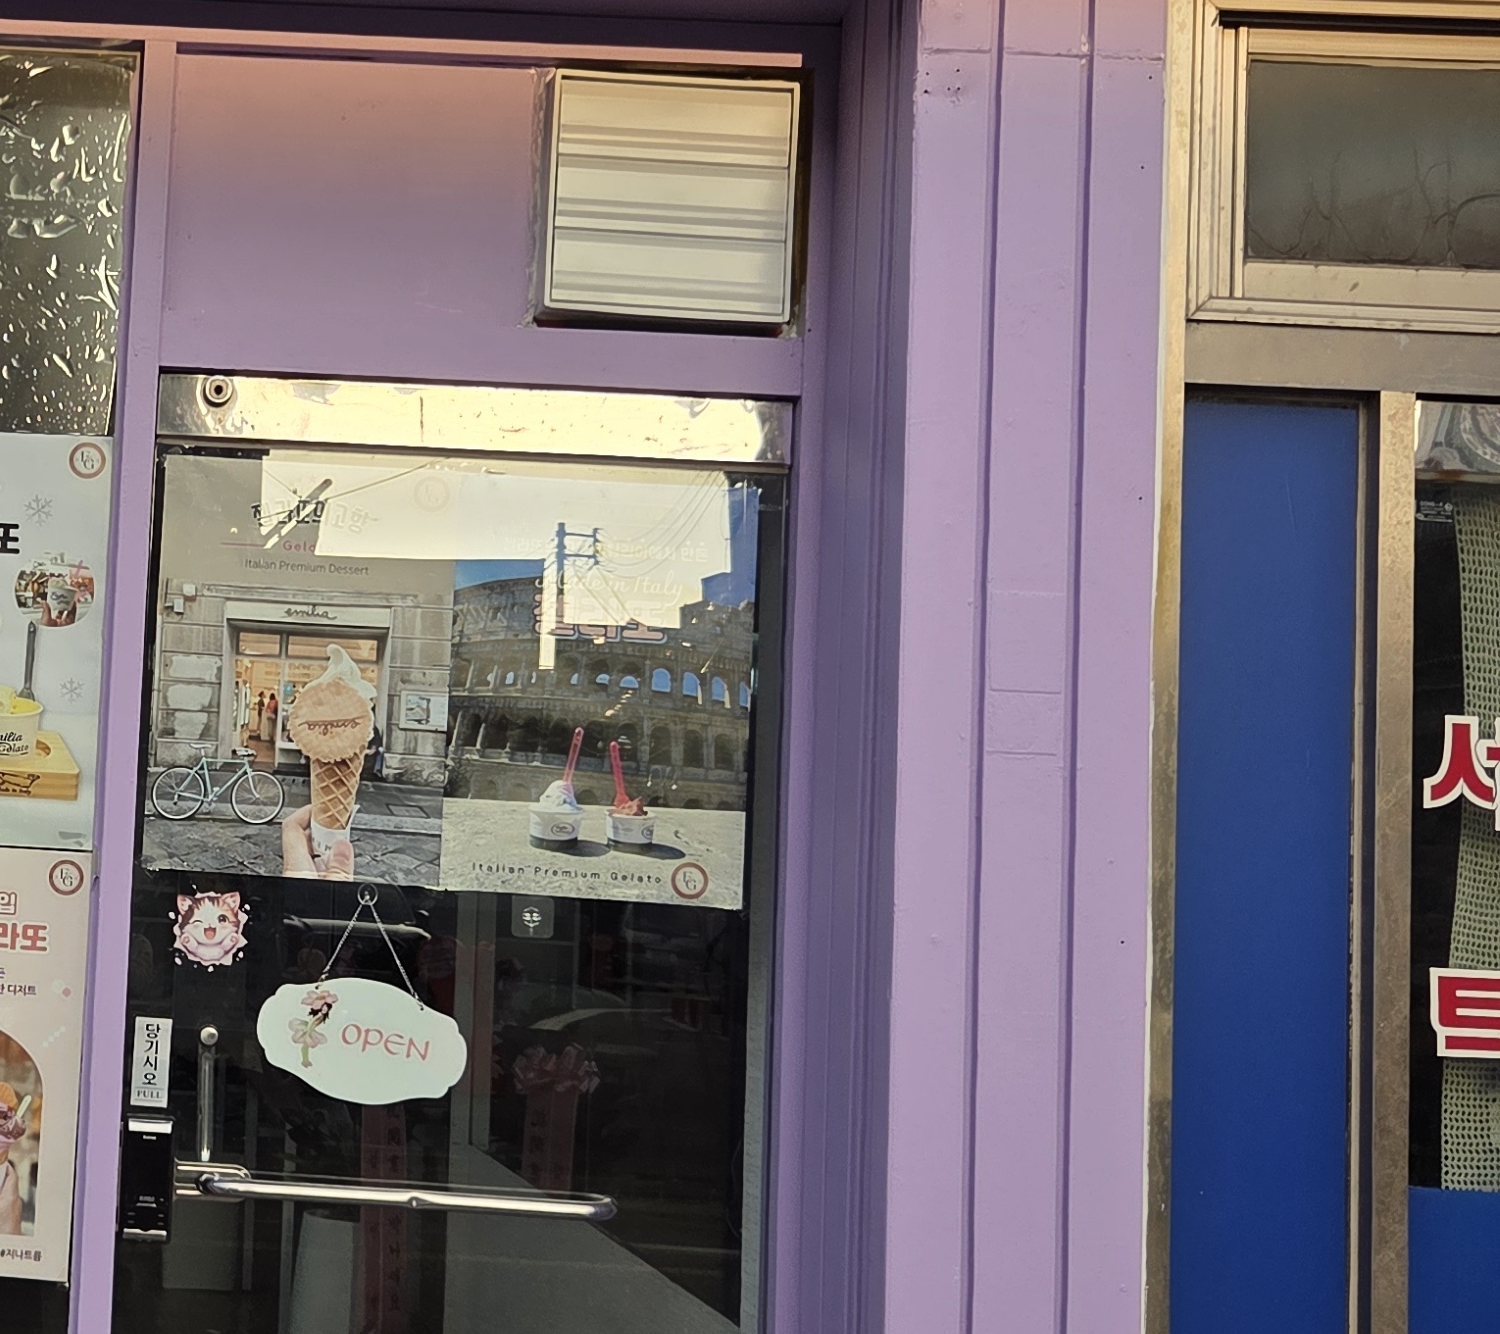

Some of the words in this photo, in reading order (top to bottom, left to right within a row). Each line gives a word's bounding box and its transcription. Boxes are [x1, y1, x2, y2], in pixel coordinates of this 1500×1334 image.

[244, 558, 277, 570] Italian
[279, 560, 326, 574] Premium
[328, 563, 369, 576] Dessert
[472, 862, 526, 875] Italian
[534, 866, 601, 880] Premium
[610, 871, 662, 884] Gelato
[340, 1022, 431, 1063] OPEN
[142, 1023, 162, 1086] 당기시오
[137, 1089, 162, 1100] PULL
